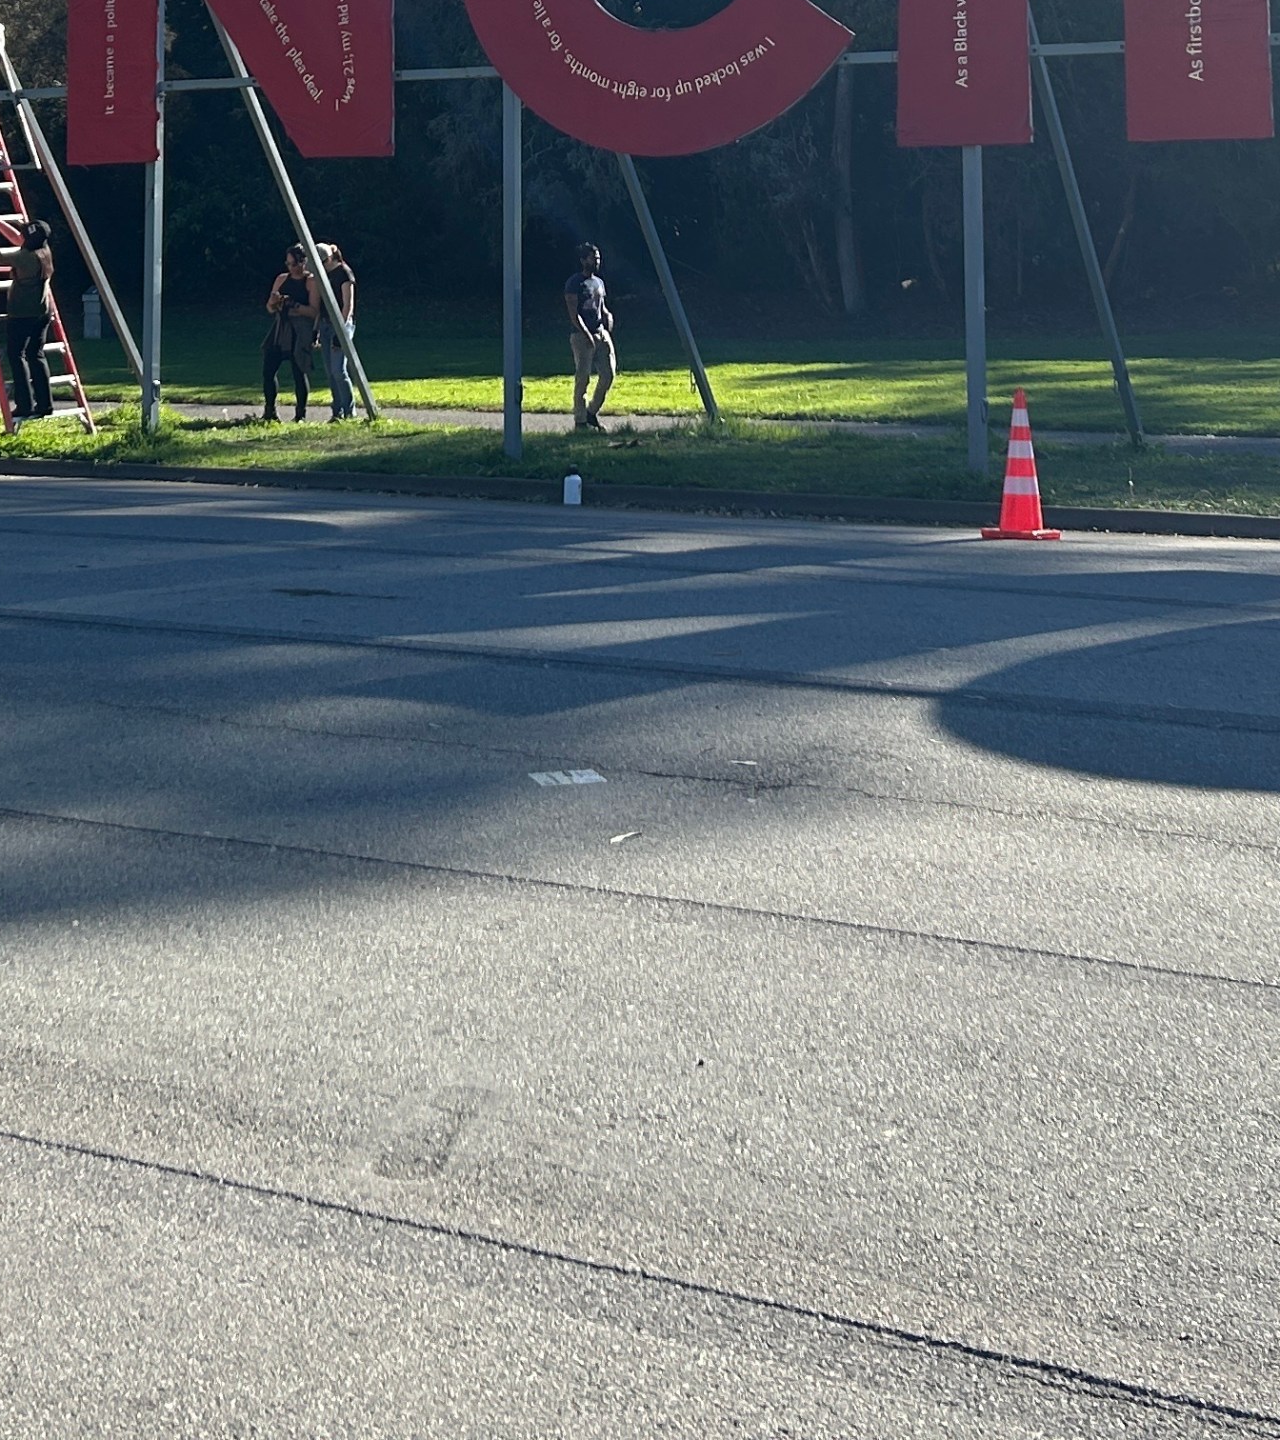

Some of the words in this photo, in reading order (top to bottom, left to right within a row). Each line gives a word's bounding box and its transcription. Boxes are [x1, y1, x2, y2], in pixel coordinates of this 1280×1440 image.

[336, 3, 350, 26] kid
[541, 16, 552, 28] a
[340, 30, 353, 52] my
[546, 29, 563, 52] for
[764, 36, 776, 47] I
[952, 10, 968, 52] Black
[274, 21, 290, 46] the
[284, 46, 306, 75] plea
[302, 73, 324, 104] deal.
[341, 53, 354, 76] 21;
[739, 43, 768, 67] was
[957, 55, 968, 65] a
[563, 48, 610, 89] months,
[694, 60, 741, 94] locked
[954, 68, 969, 88] As
[1187, 59, 1204, 82] As
[339, 77, 356, 104] was
[611, 80, 648, 100] eight
[649, 86, 672, 102] for
[674, 78, 693, 96] up
